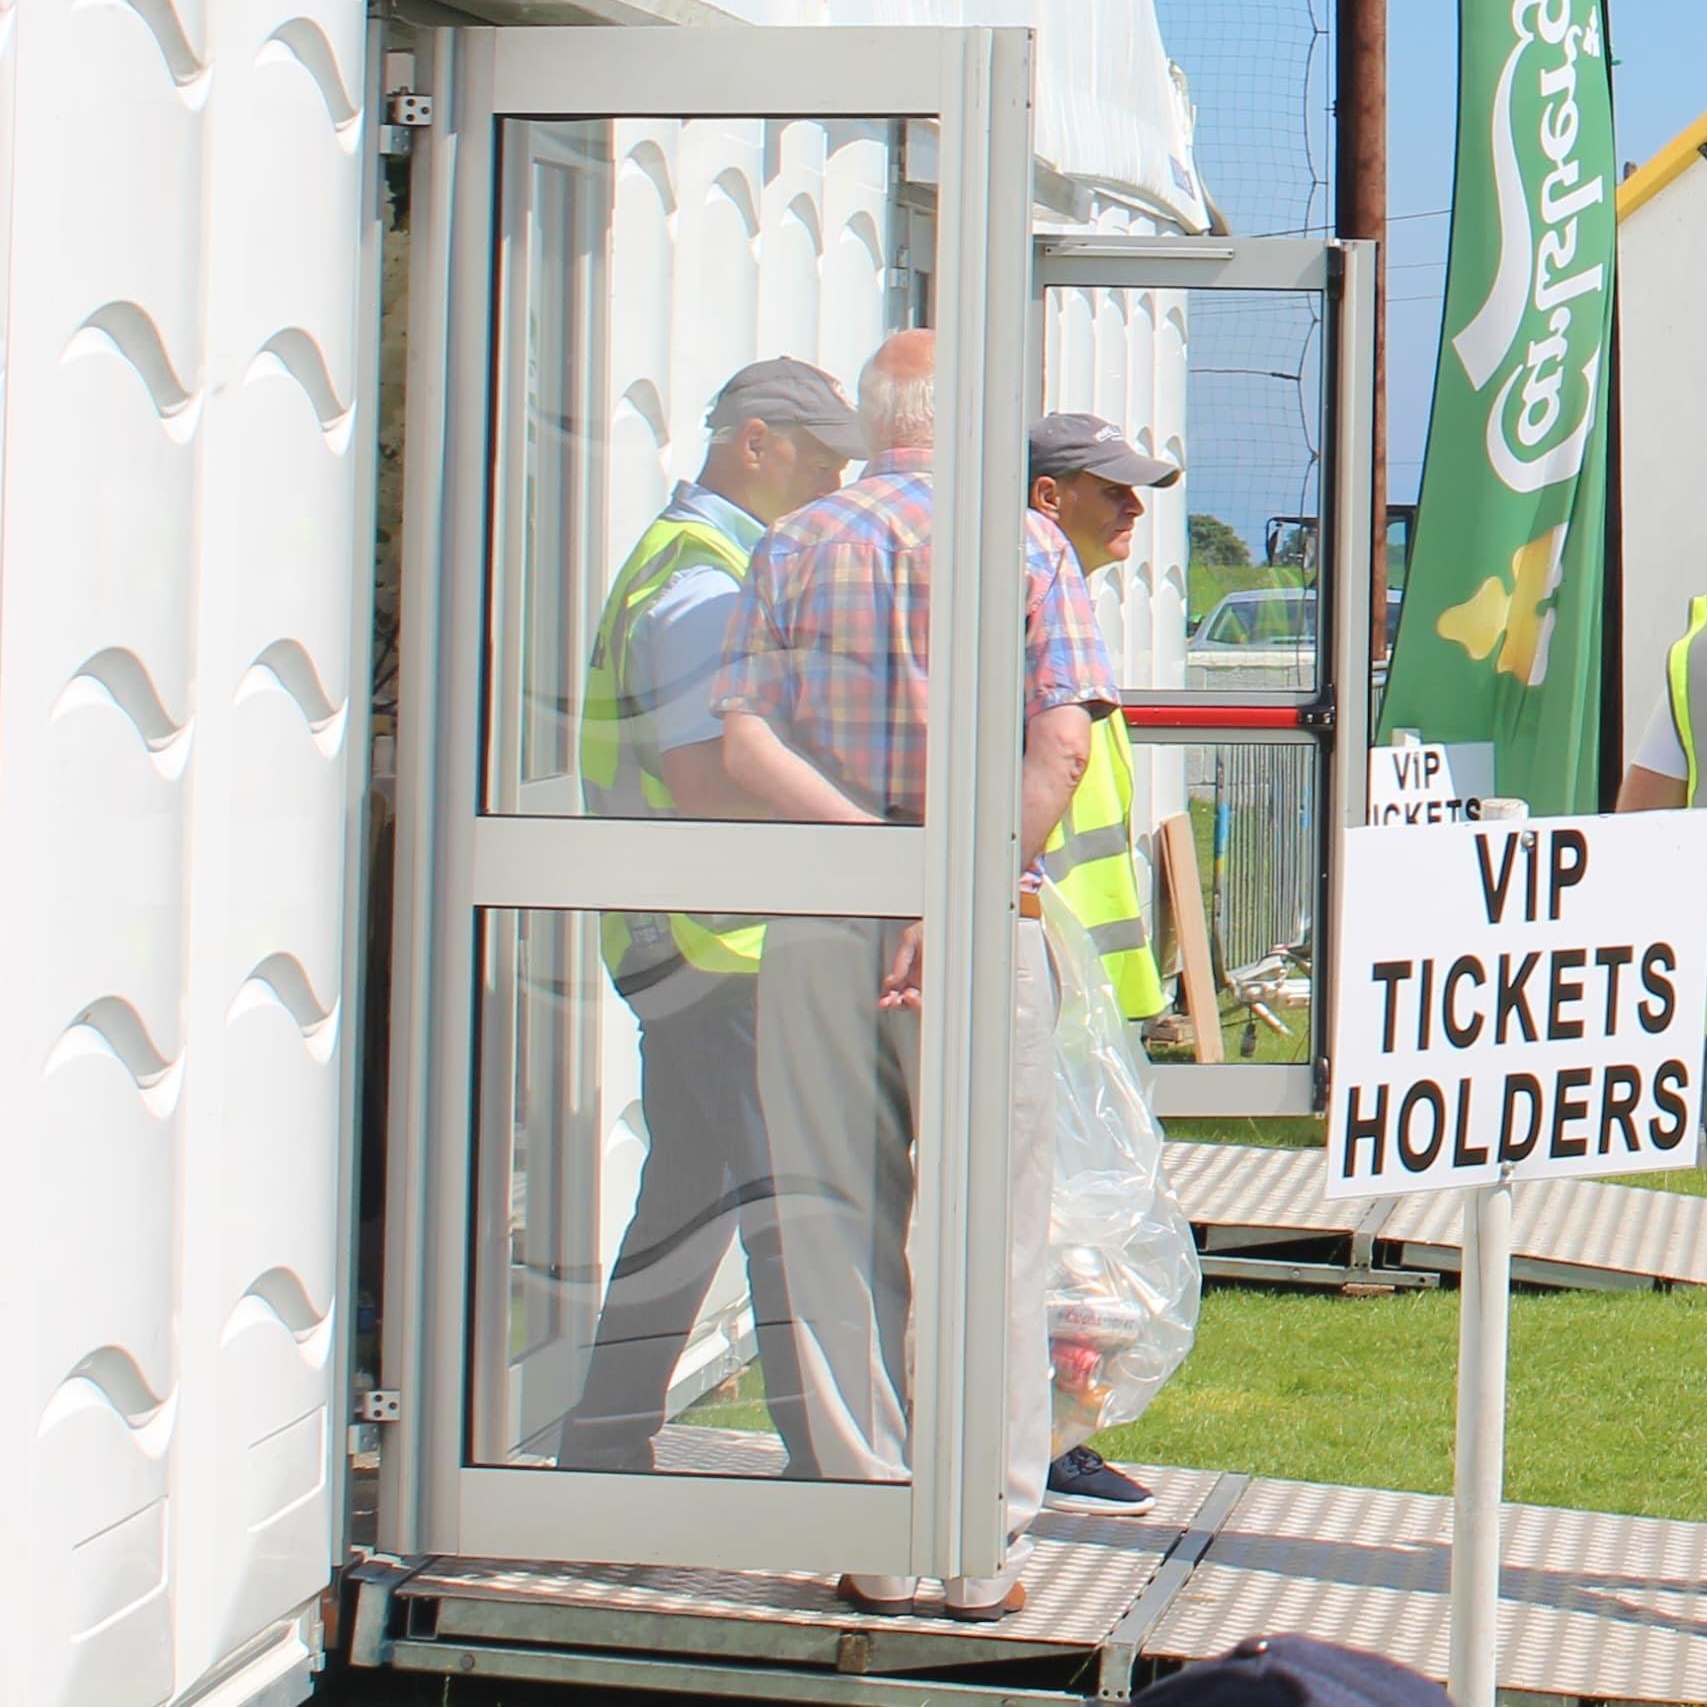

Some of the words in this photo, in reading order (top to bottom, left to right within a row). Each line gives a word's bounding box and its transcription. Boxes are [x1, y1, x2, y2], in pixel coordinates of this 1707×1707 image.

[1392, 750, 1440, 790] VIP
[1474, 828, 1588, 926] VIP
[1371, 941, 1677, 1055] TICKETS
[1341, 1057, 1690, 1181] HOLDERS
